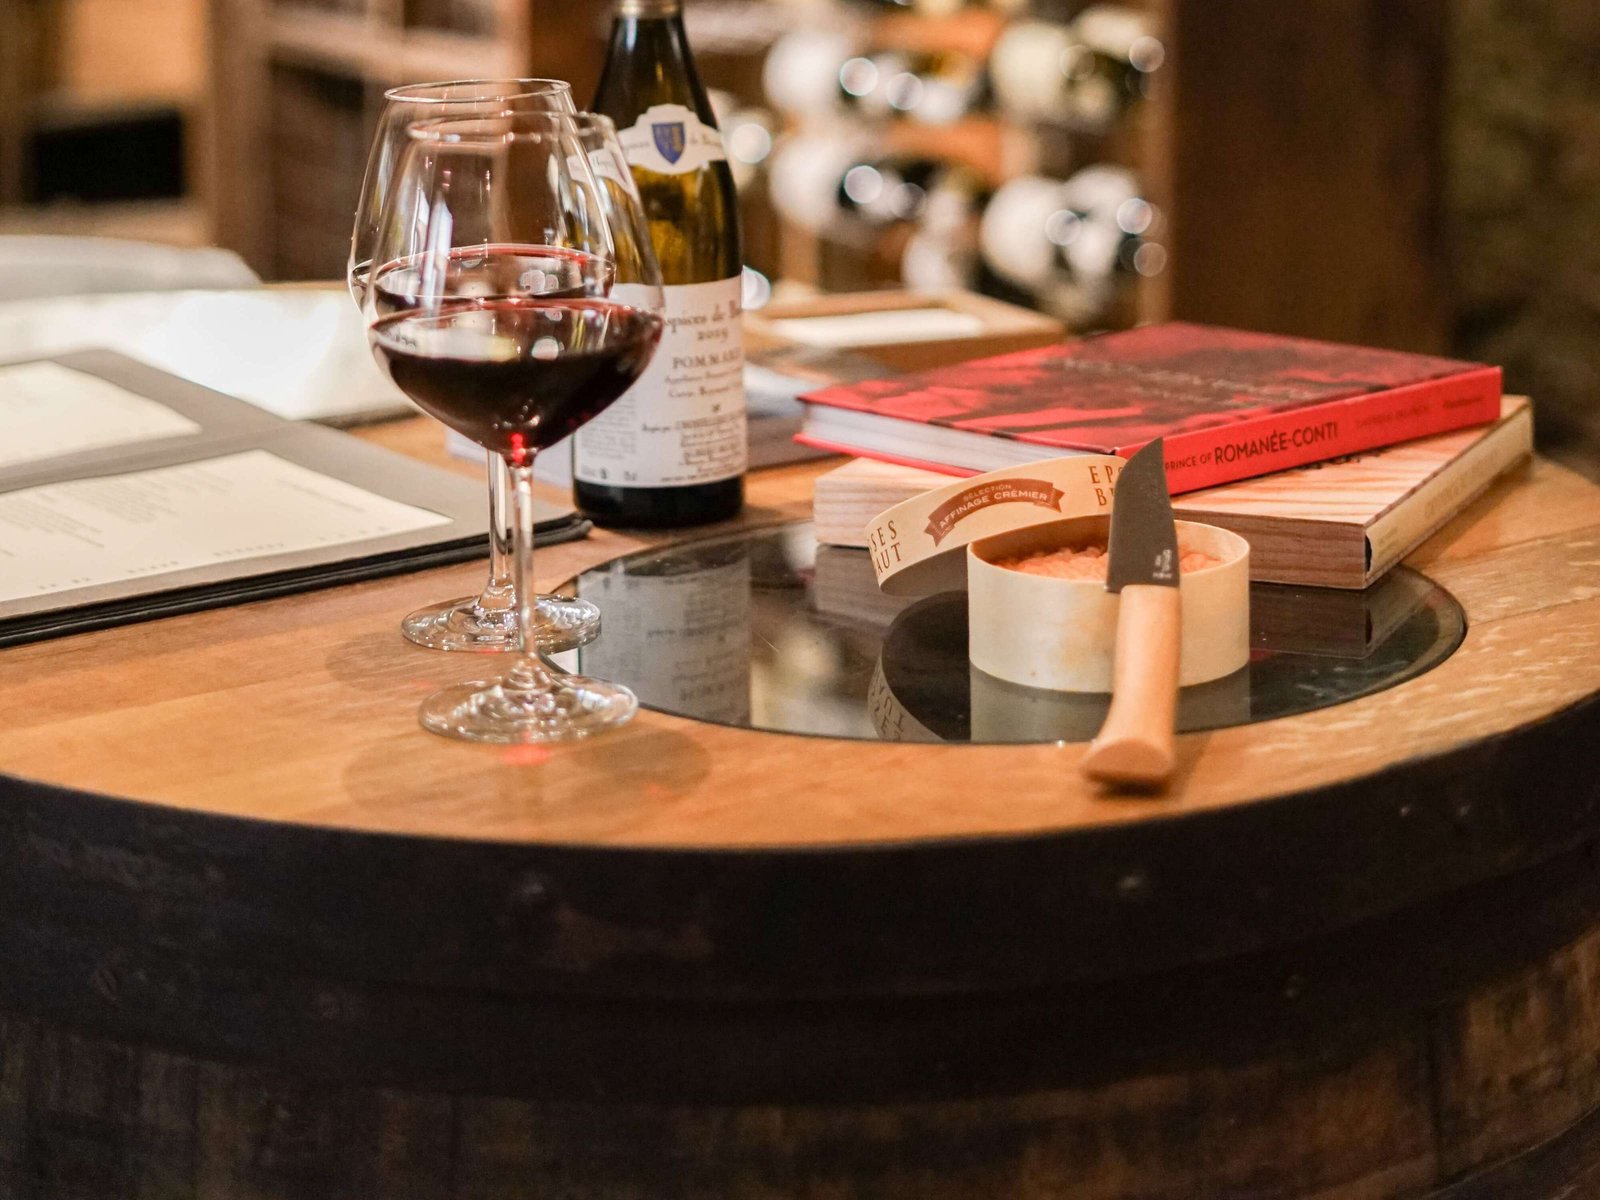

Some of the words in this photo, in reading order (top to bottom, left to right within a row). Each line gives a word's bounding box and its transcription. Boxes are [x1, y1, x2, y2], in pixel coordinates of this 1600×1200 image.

[1199, 452, 1212, 465] OF
[1214, 421, 1339, 465] ROMANÉE-CONTI
[939, 495, 990, 528] AFFINAGE
[993, 487, 1049, 502] CRÉMIER
